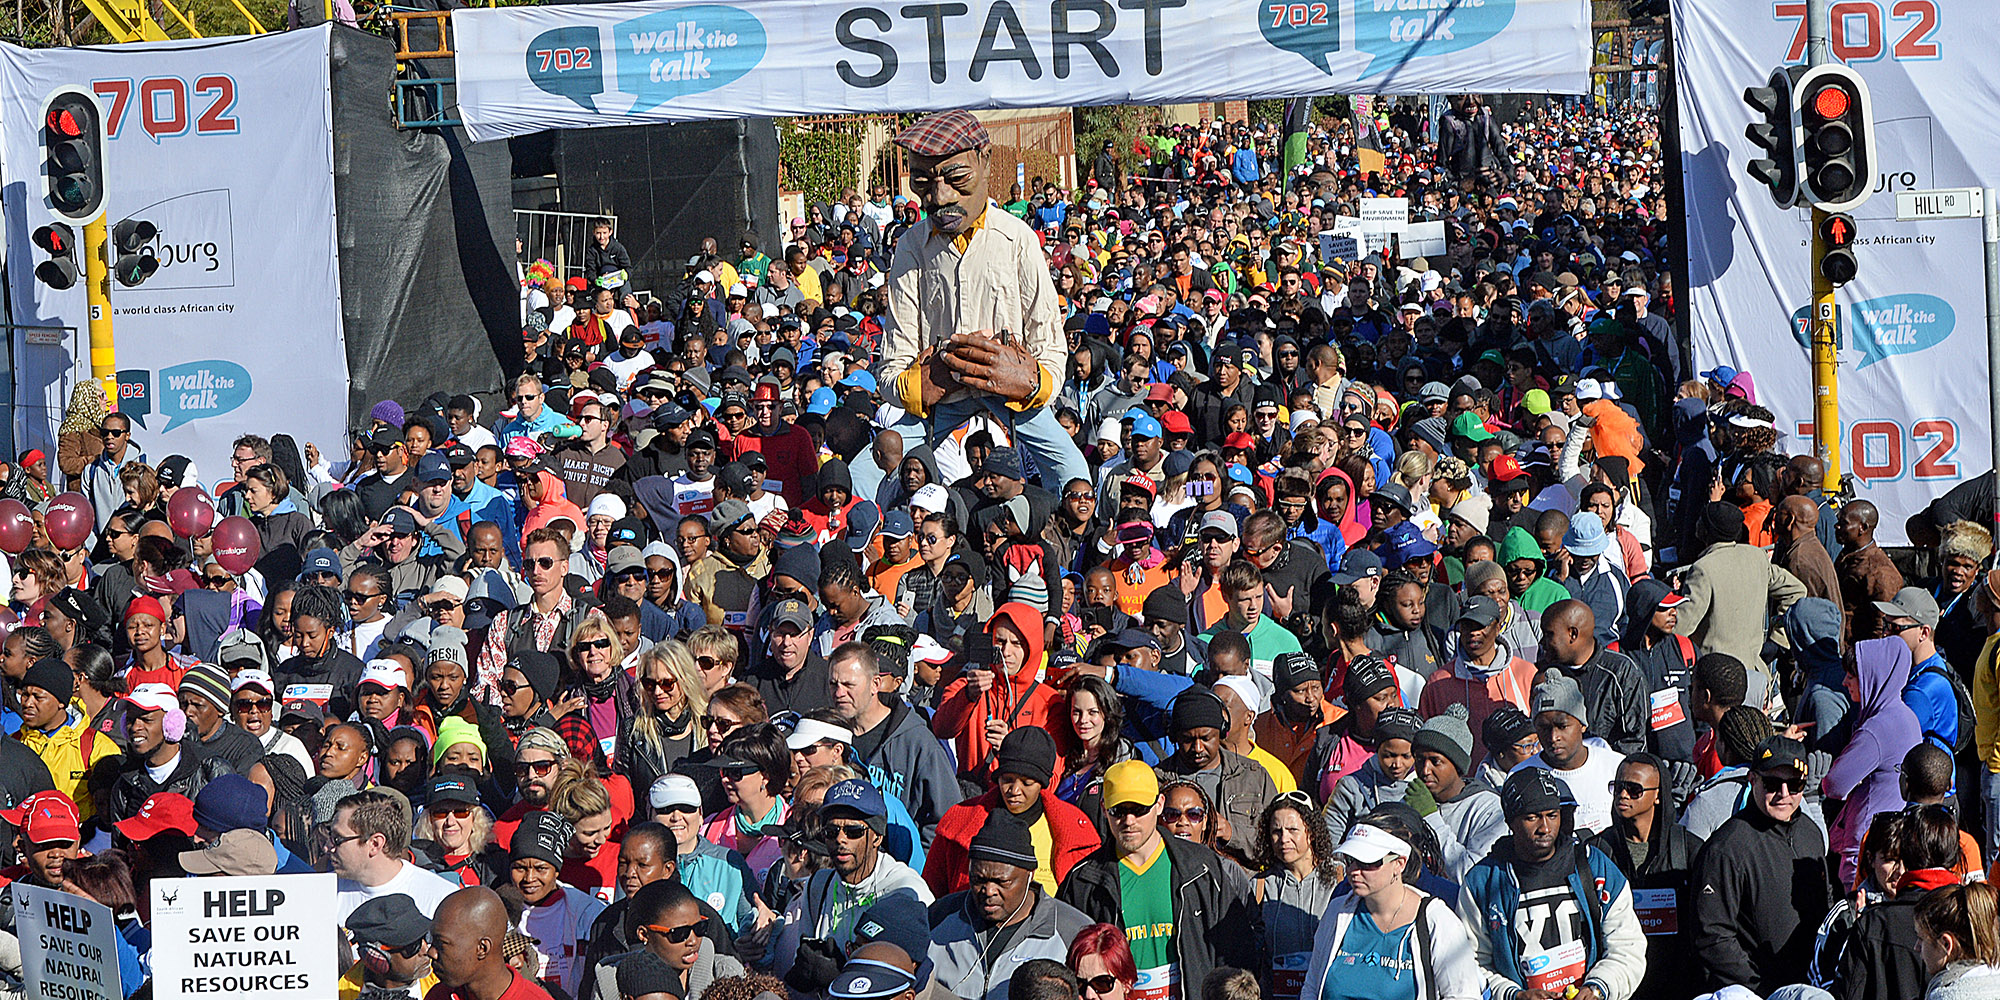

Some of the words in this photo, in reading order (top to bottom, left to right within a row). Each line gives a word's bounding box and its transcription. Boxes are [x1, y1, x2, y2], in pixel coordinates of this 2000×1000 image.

[1268, 4, 1330, 29] 702
[1389, 10, 1456, 42] talk
[629, 21, 706, 55] walk
[706, 29, 739, 49] the
[1774, 0, 1942, 66] 702
[834, 0, 1188, 88] START
[535, 47, 593, 73] 702
[649, 51, 712, 84] talk
[90, 74, 240, 145] 702
[1914, 196, 1943, 215] HILL
[1944, 194, 1955, 207] RD
[1331, 232, 1351, 241] HELP
[1853, 236, 1870, 245] ass
[1873, 235, 1912, 245] African
[1915, 234, 1936, 245] city
[91, 306, 101, 320] 5
[113, 307, 119, 315] a
[120, 305, 150, 315] world
[153, 304, 177, 314] class
[179, 303, 215, 314] African
[217, 303, 235, 314] city
[1821, 304, 1830, 318] 6
[1861, 304, 1914, 325] walk
[1914, 311, 1936, 323] the
[1874, 325, 1917, 345] talk
[168, 369, 215, 391] walk
[215, 377, 235, 389] the
[179, 390, 218, 410] talk
[563, 458, 590, 470] MAAST
[590, 474, 610, 487] RSIT
[203, 889, 286, 918] HELP
[44, 901, 92, 936] HELP
[188, 926, 246, 943] SAVE
[253, 925, 300, 942] OUR
[1125, 924, 1148, 941] UTH
[1150, 922, 1174, 938] AFR
[39, 934, 74, 956] SAVE
[78, 942, 103, 965] OUR
[193, 950, 297, 968] NATURAL
[45, 957, 104, 987] NATURAL
[181, 973, 309, 994] RESOURCES
